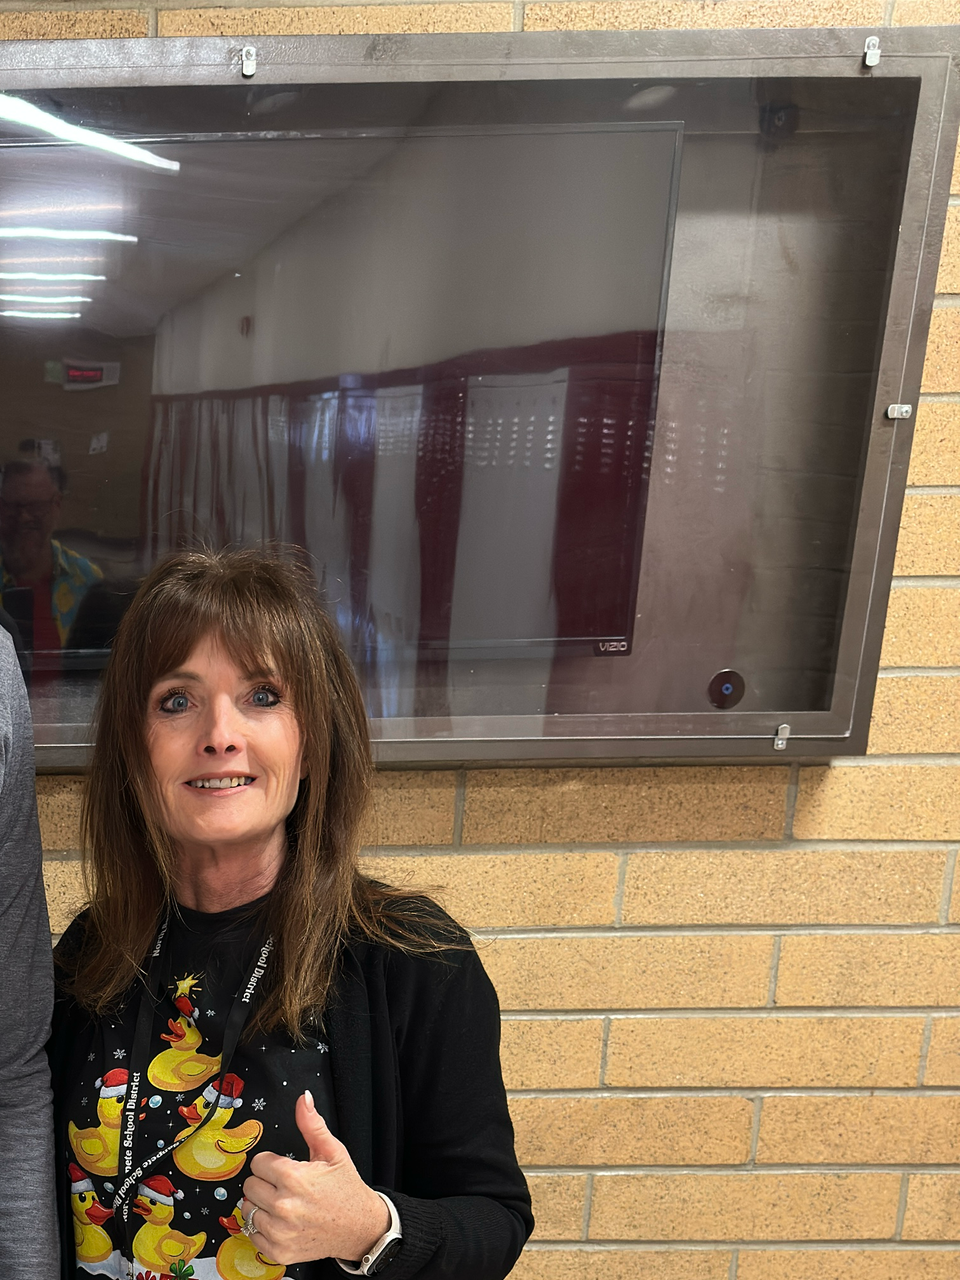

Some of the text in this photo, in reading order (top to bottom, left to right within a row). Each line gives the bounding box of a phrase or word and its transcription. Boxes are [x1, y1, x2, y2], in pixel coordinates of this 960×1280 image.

[599, 642, 627, 651] VIZIO
[241, 967, 265, 1003] District
[126, 1072, 141, 1109] District
[123, 1112, 135, 1148] School
[118, 1167, 143, 1198] School
